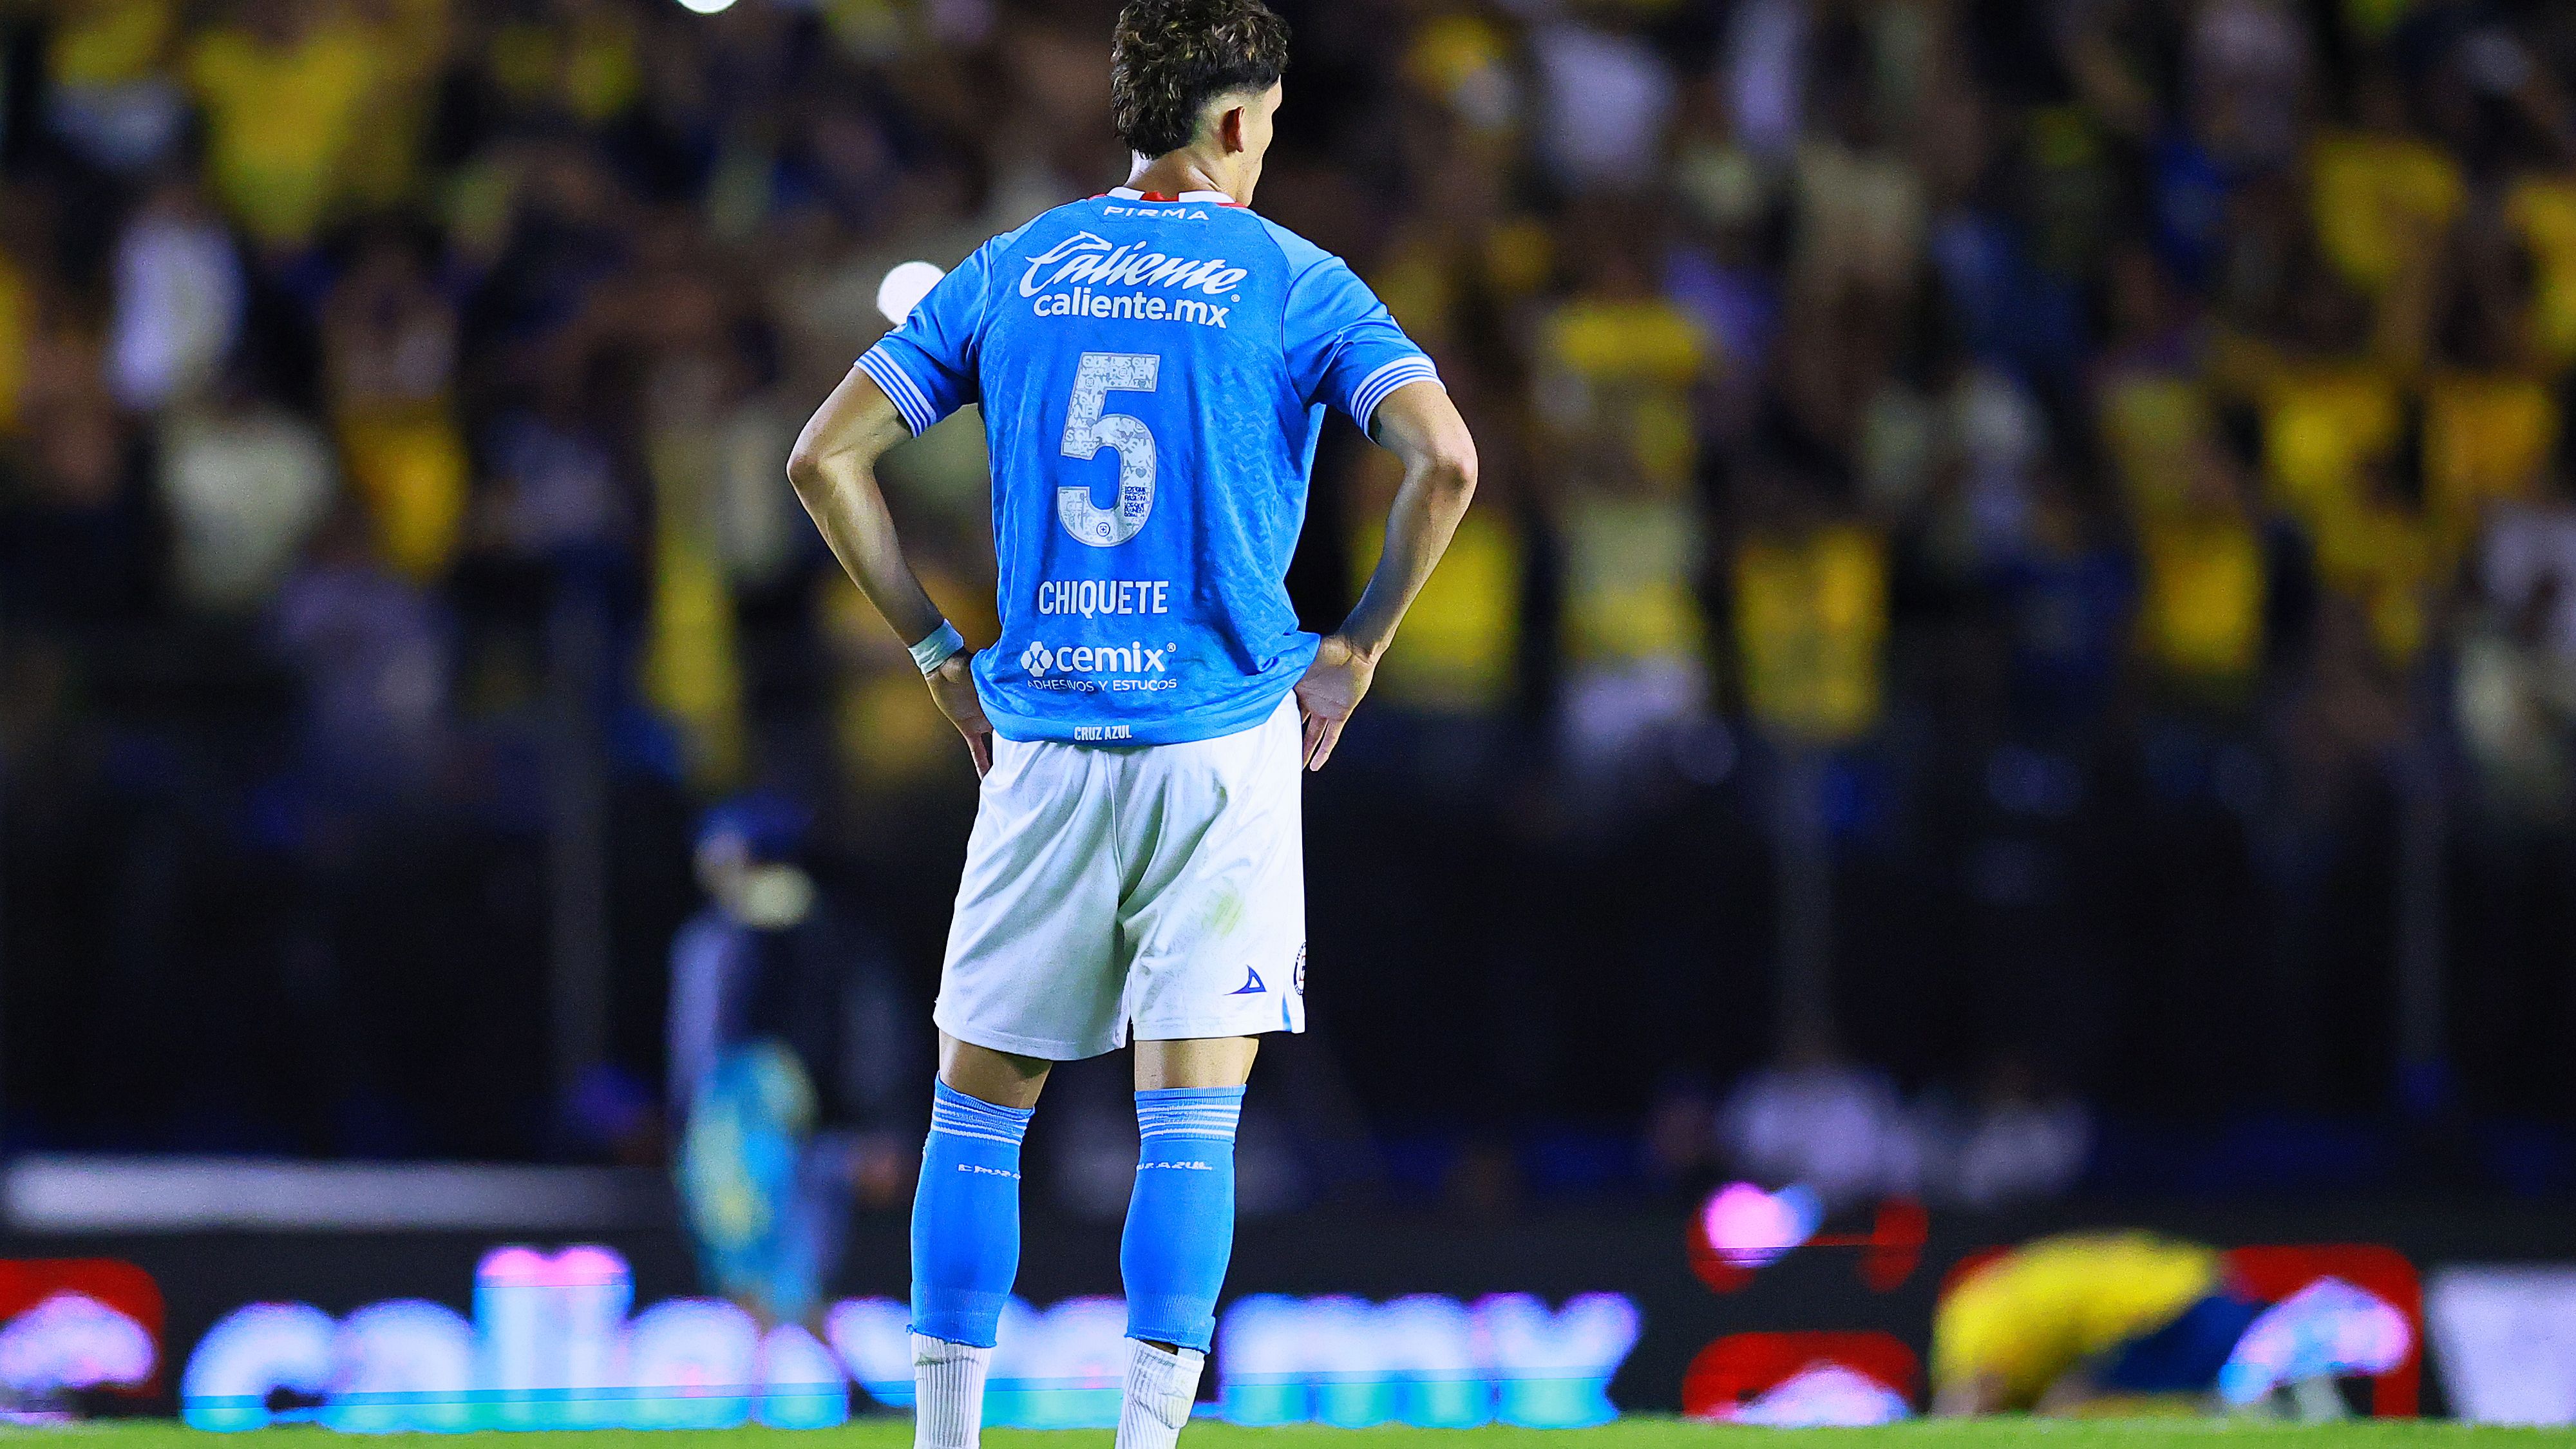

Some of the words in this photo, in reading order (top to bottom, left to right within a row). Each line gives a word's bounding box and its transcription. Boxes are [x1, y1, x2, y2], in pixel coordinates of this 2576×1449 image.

[1103, 205, 1209, 221] PIRMA
[1019, 231, 1247, 298] Caliente
[1034, 287, 1230, 328] caliente.mx
[1057, 352, 1160, 547] 5
[1039, 580, 1169, 619] CHIQUETE
[1056, 641, 1166, 673] cemix
[1027, 679, 1094, 692] ADHESIVOS
[1098, 680, 1108, 691] Y
[1113, 678, 1177, 691] ESTUCOS
[1074, 726, 1103, 741] CRUZ
[1104, 724, 1132, 740] AZUL
